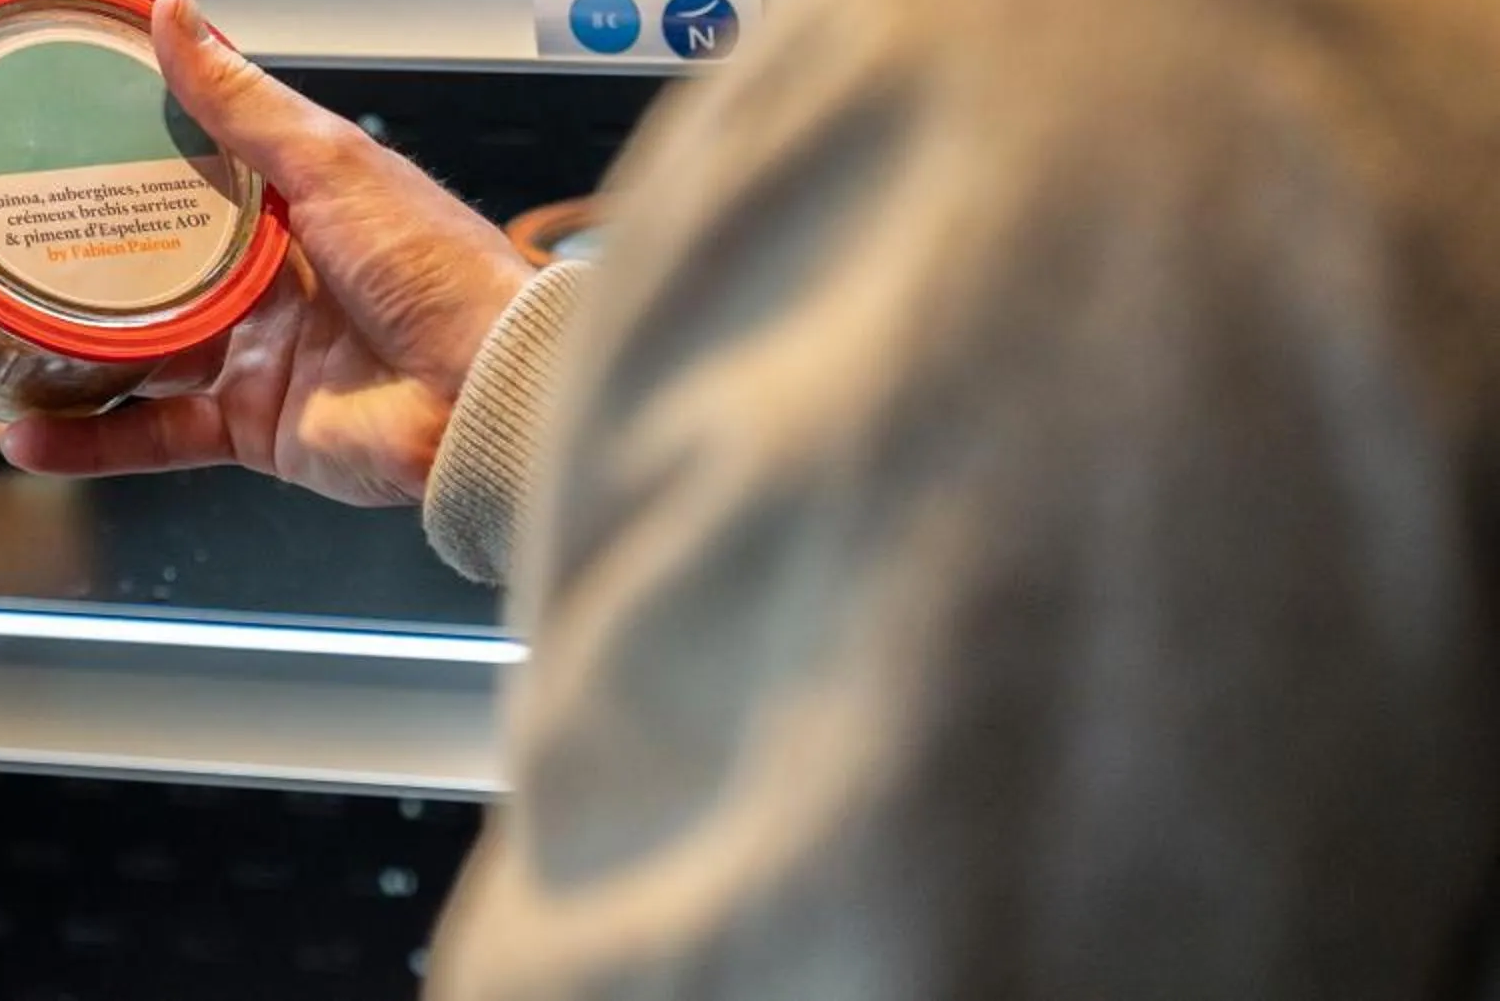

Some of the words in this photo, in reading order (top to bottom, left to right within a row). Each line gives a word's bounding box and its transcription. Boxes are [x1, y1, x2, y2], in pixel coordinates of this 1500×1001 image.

[687, 25, 716, 51] N
[49, 183, 139, 204] aubergines,
[141, 177, 211, 195] tomates,
[7, 204, 77, 227] crémeux
[79, 199, 130, 218] brebis
[131, 195, 199, 214] sarriette
[4, 231, 21, 247] &
[24, 225, 81, 248] piment
[175, 213, 212, 230] AOP
[46, 247, 66, 262] by
[70, 241, 126, 260] Fabien
[127, 236, 182, 255] Pairon
